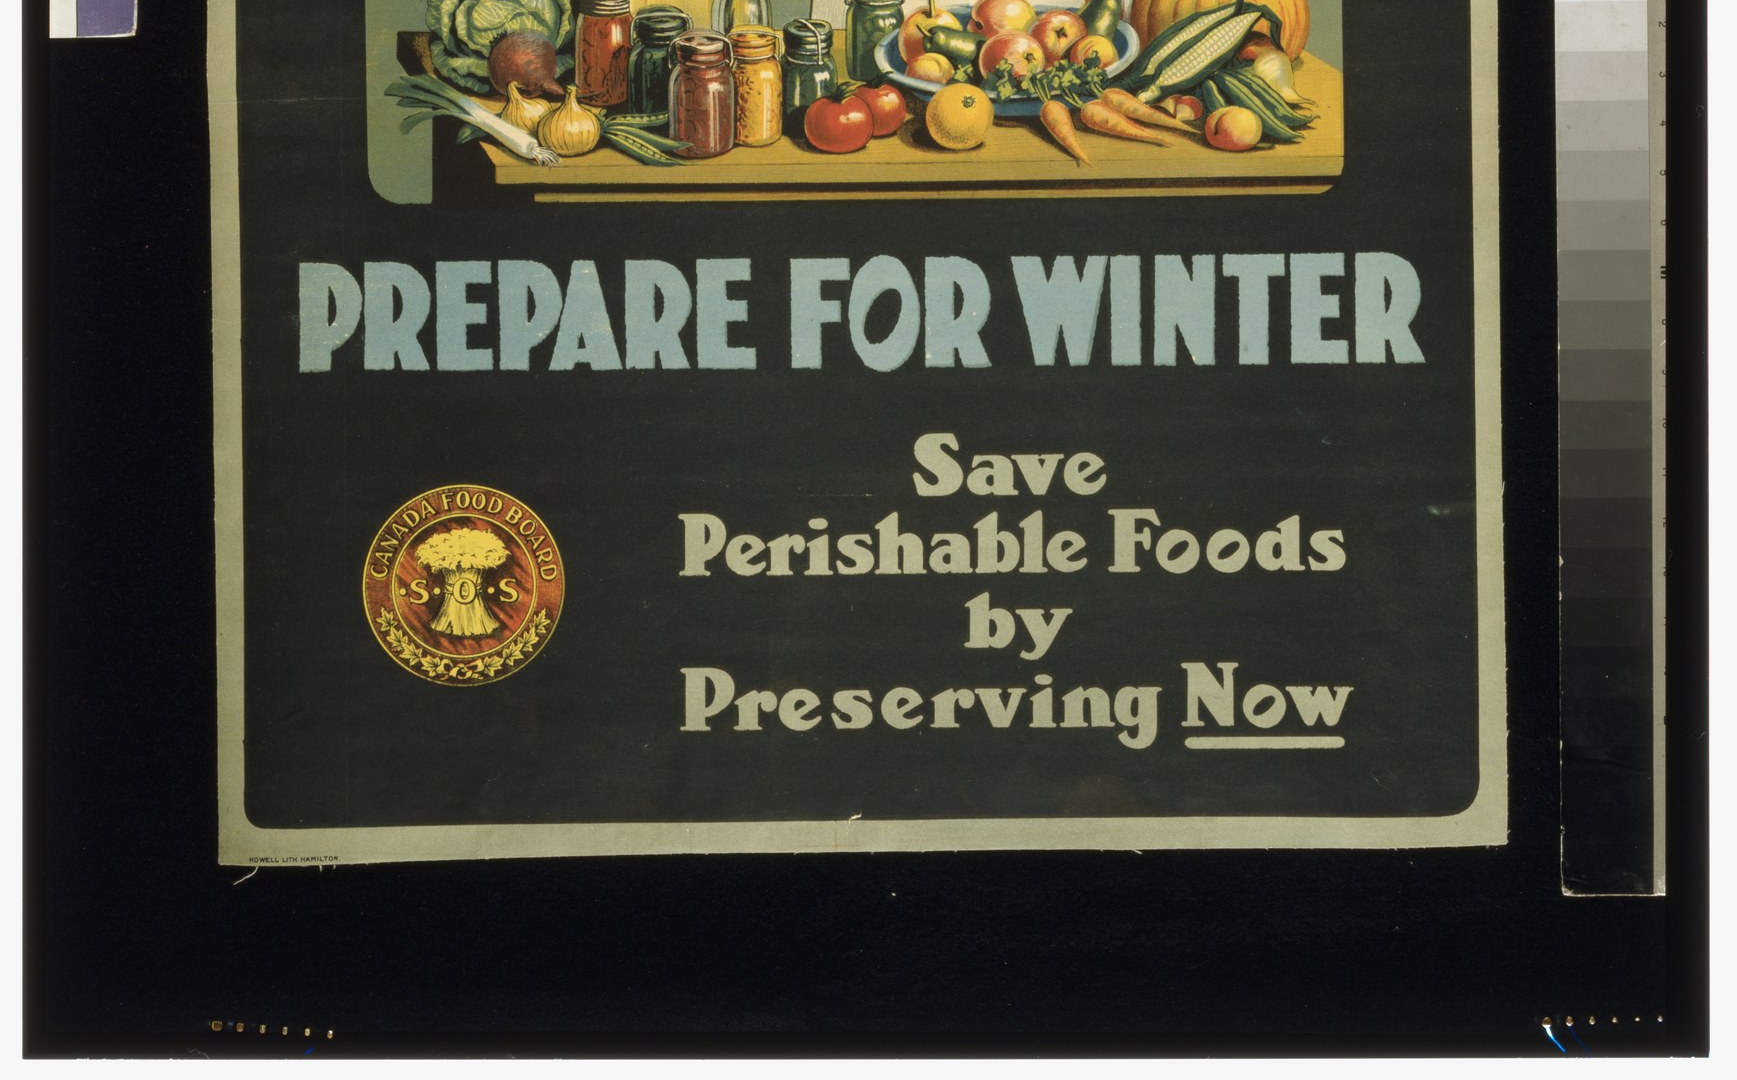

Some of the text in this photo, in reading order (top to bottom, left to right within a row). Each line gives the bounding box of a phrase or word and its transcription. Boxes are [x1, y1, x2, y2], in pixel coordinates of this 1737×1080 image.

[298, 251, 1426, 373] PREPARE FOR WINTER
[912, 432, 1107, 497] Save
[371, 490, 558, 582] CANADA FOOD BOARD
[677, 508, 1347, 577] Perishable Foods
[963, 591, 1074, 661] by
[679, 661, 1355, 750] Preserving Now
[249, 856, 280, 864] HOWELL
